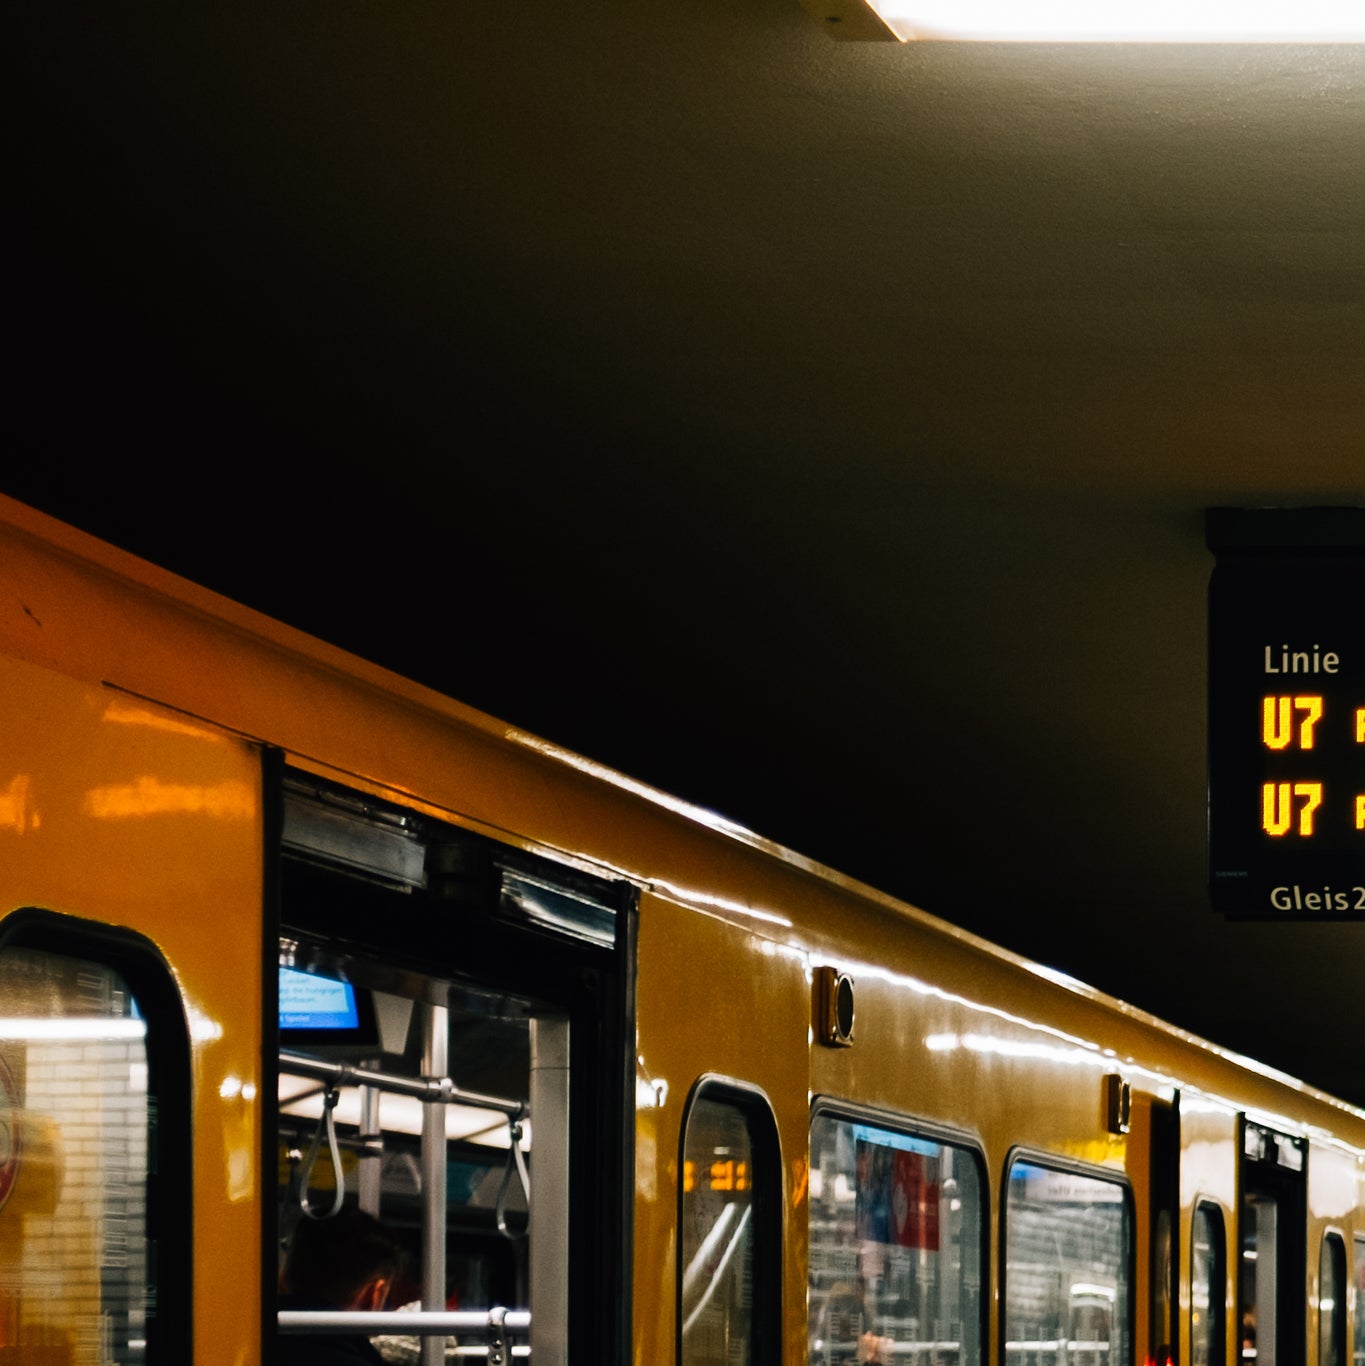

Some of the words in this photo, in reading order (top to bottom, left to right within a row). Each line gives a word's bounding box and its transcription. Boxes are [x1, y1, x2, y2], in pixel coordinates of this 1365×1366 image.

[1265, 644, 1340, 674] Linie
[1263, 697, 1322, 749] U7
[1263, 783, 1322, 836] U7
